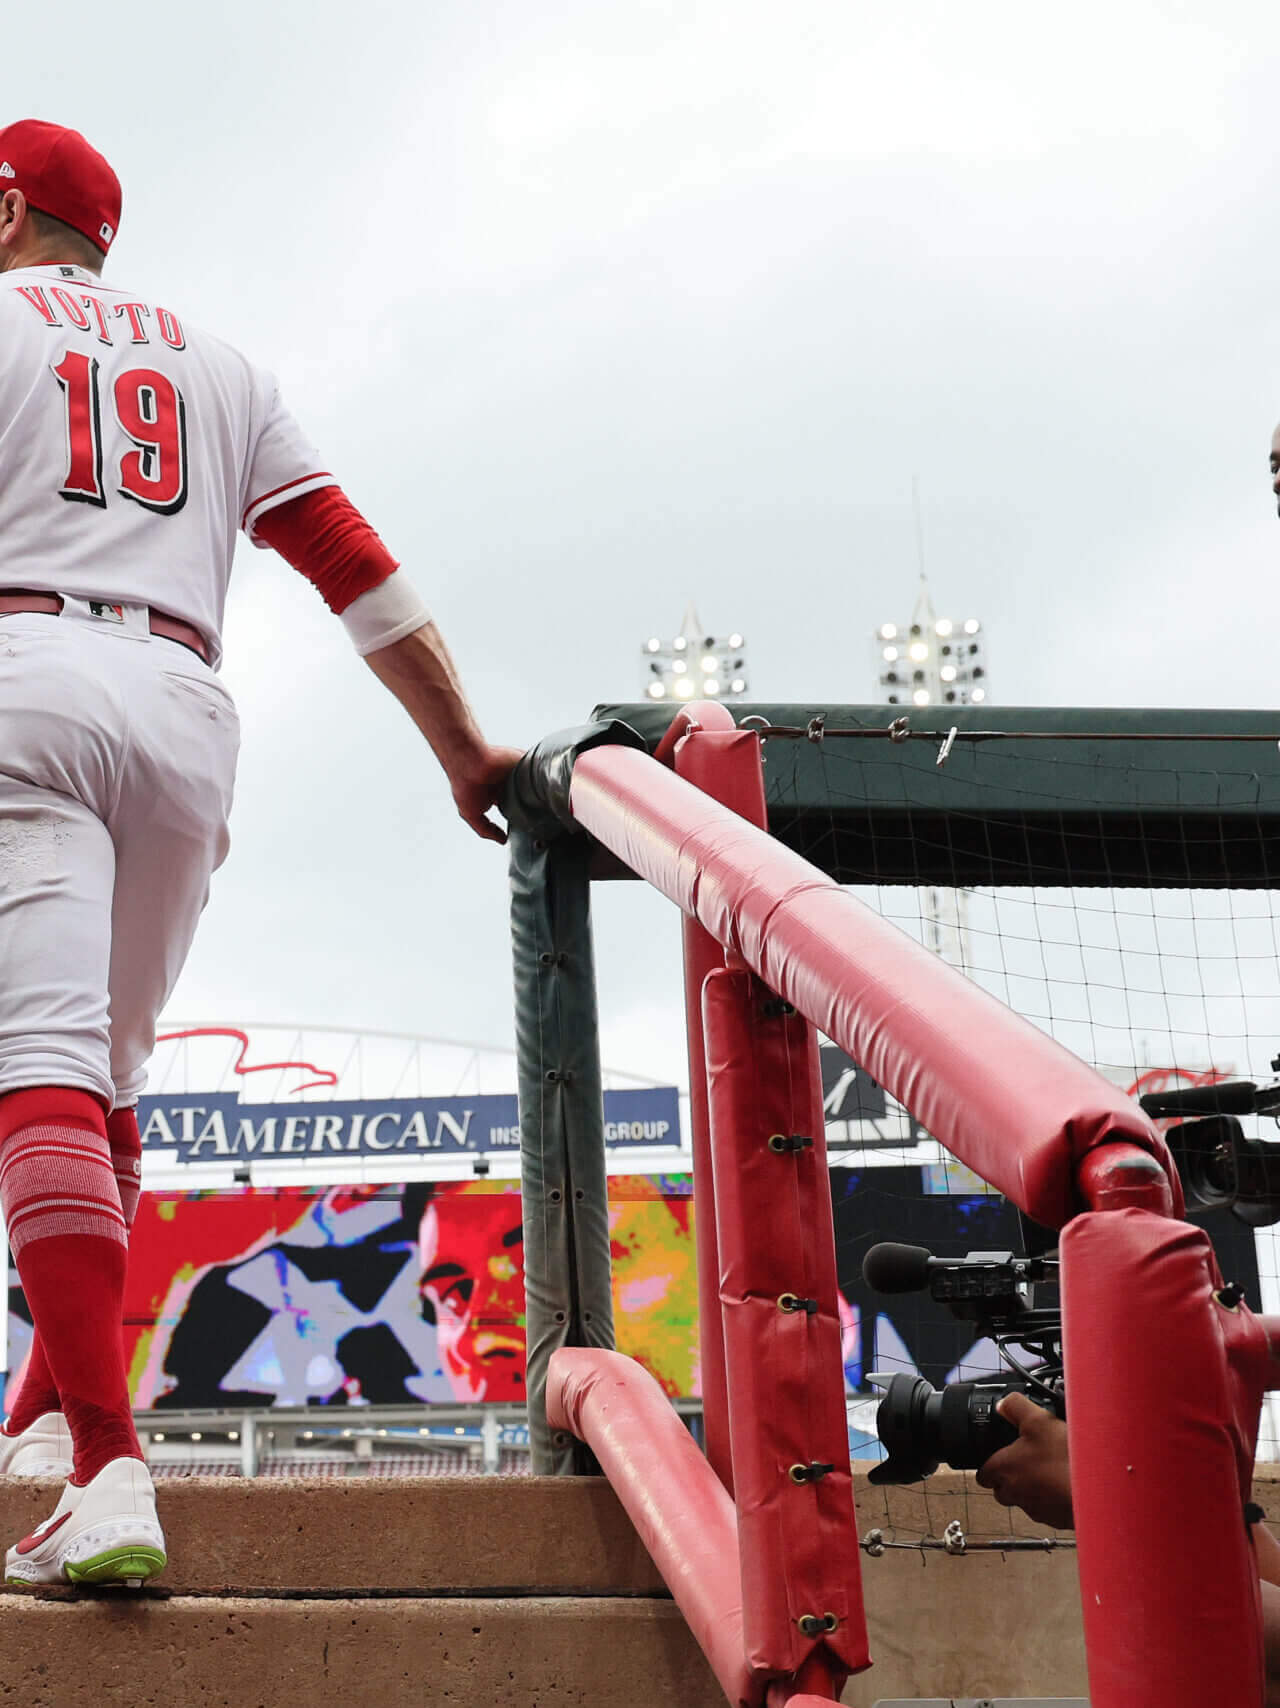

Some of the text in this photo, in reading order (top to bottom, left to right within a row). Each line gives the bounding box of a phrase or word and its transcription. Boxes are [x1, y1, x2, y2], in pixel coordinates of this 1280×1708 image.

[12, 285, 186, 351] VOTTO
[48, 350, 188, 516] 19
[187, 1110, 473, 1156] AMERICAN
[605, 1121, 669, 1141] GROUP
